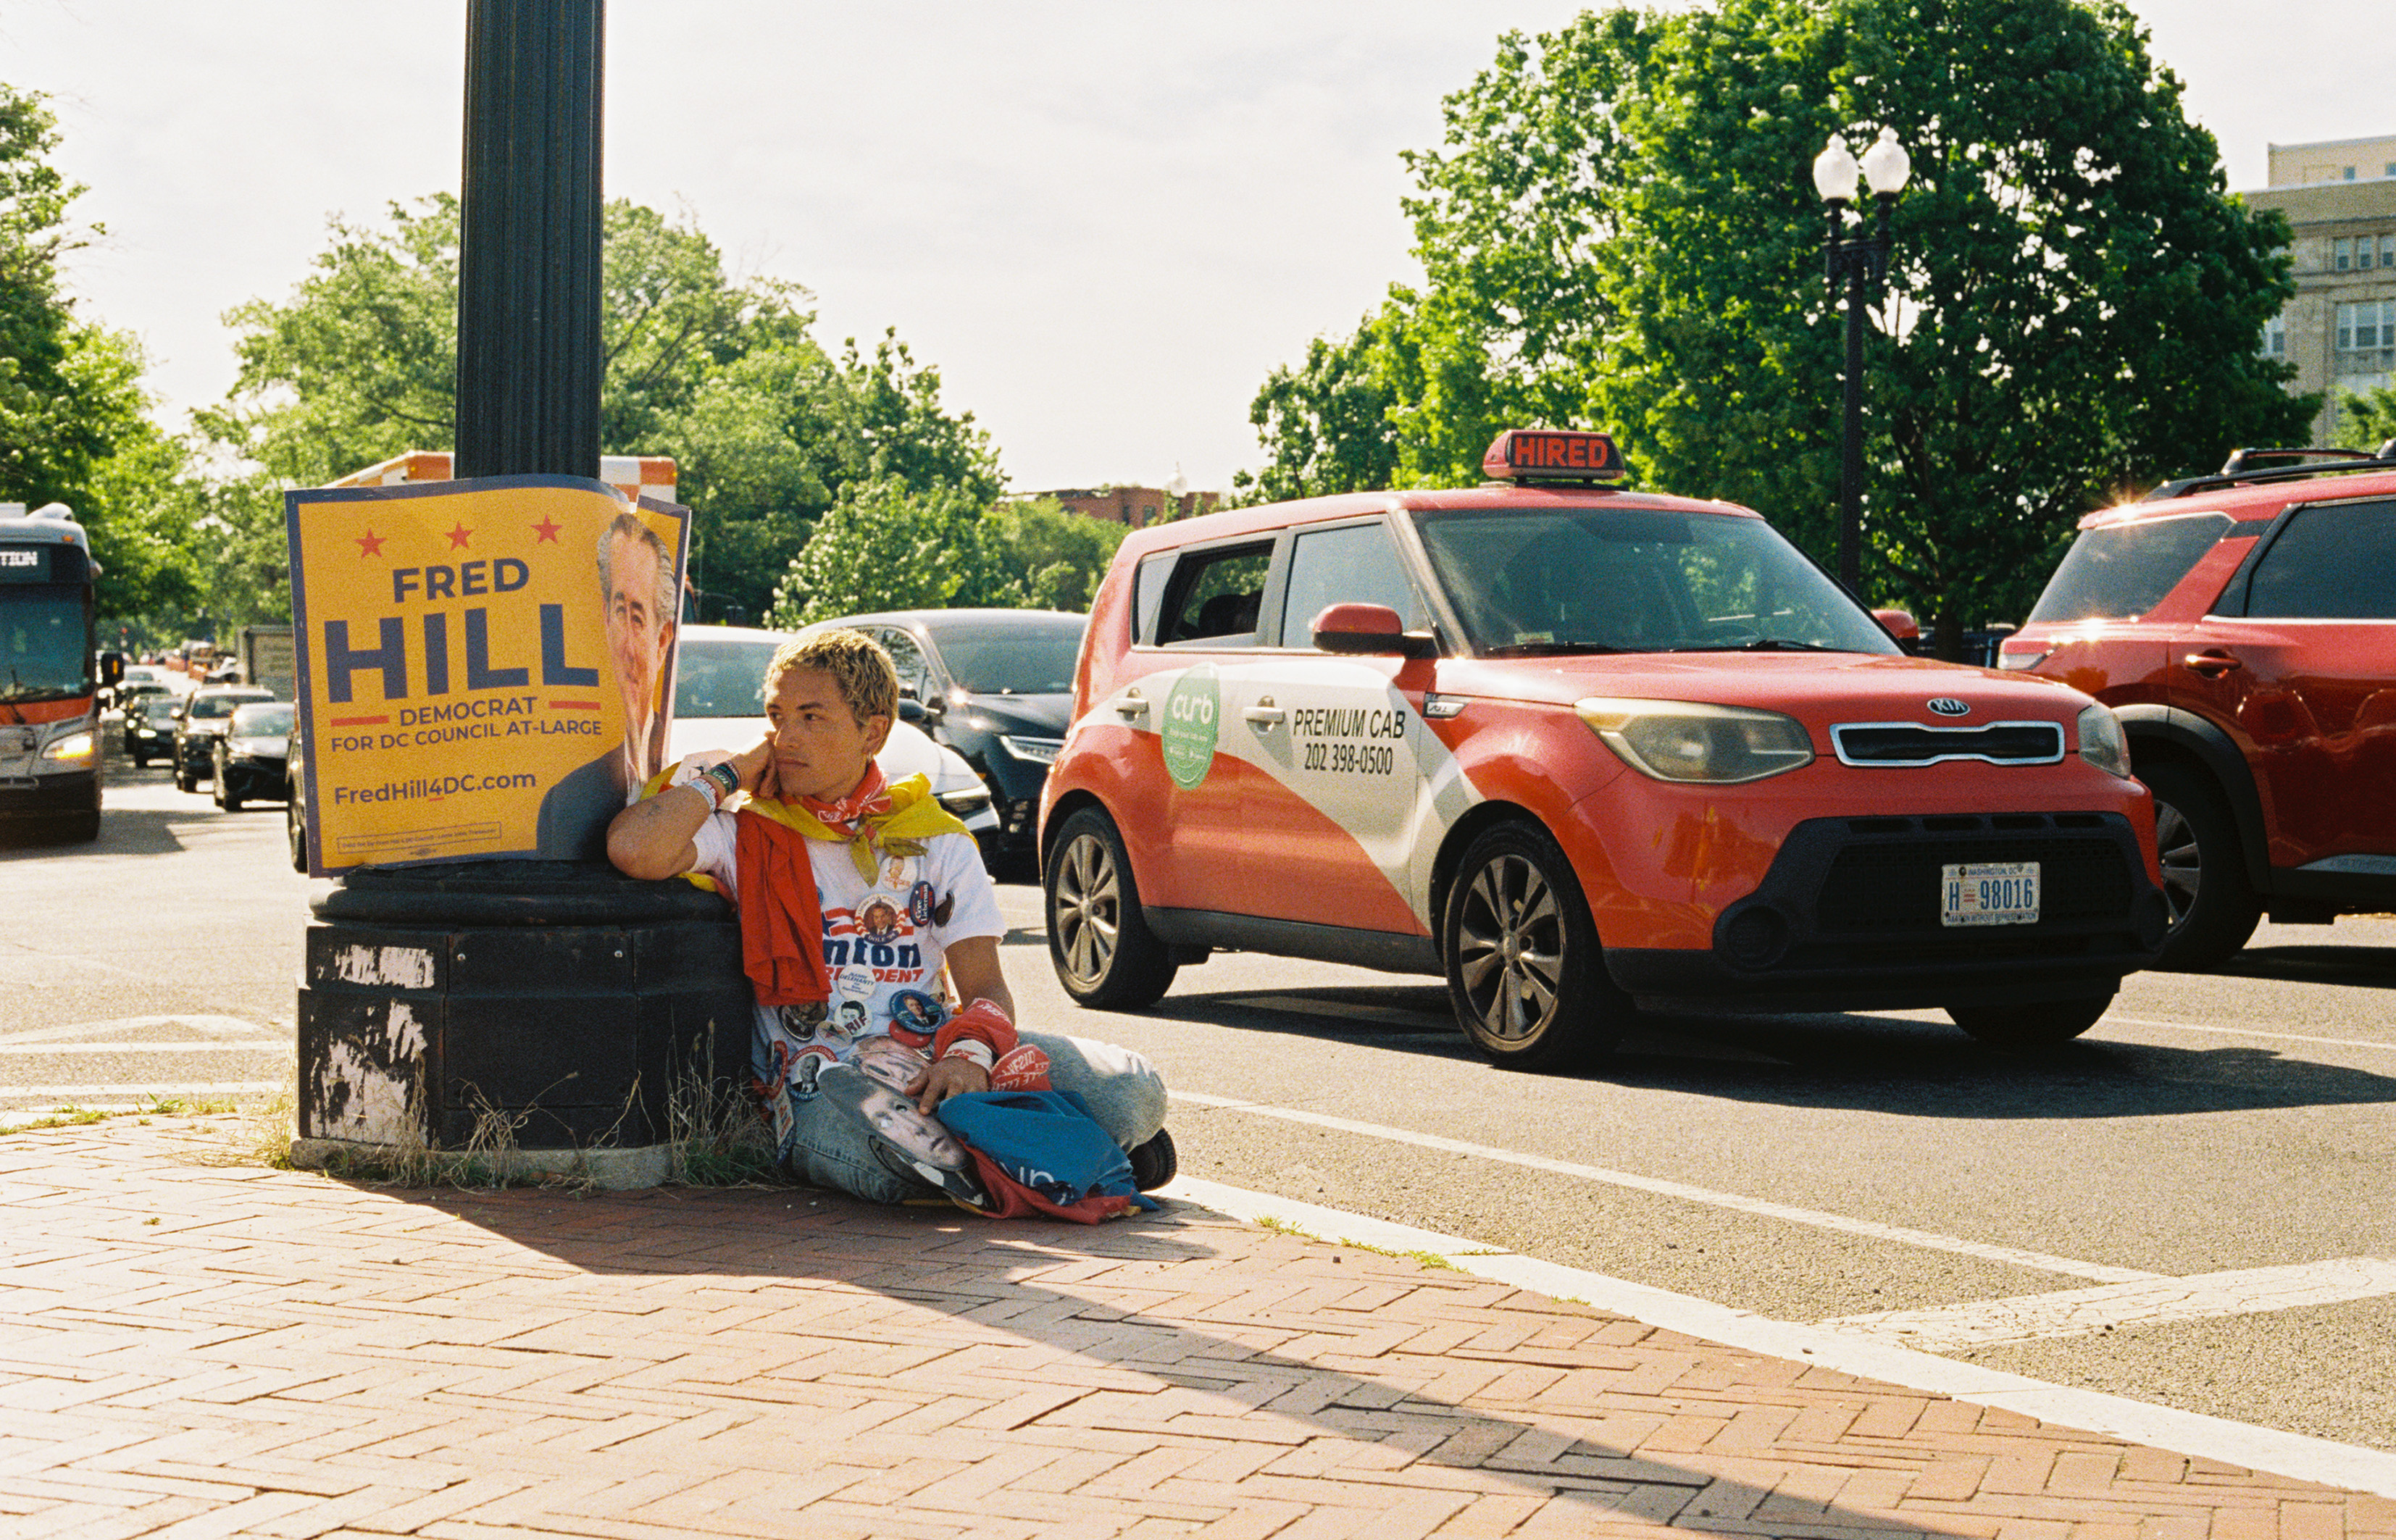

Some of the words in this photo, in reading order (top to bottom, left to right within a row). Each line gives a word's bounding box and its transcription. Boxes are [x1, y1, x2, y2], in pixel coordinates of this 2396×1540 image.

[1516, 438, 1607, 467] HIRED
[393, 557, 530, 603] FRED
[324, 604, 600, 703] HILL
[399, 696, 538, 727] DEMOCRAT
[1172, 693, 1214, 724] curb
[1295, 709, 1366, 737] PREMIUM
[1371, 710, 1406, 739] CAB
[331, 736, 374, 752] FOR
[380, 733, 409, 750] DC
[414, 723, 501, 746] COUNCIL
[506, 720, 602, 736] AT-LARGE
[1304, 742, 1327, 771] 202
[1332, 744, 1393, 775] 398-0500
[334, 772, 536, 805] FredHill4DC.com
[1948, 882, 1960, 911] H
[1979, 879, 2033, 910] 98016
